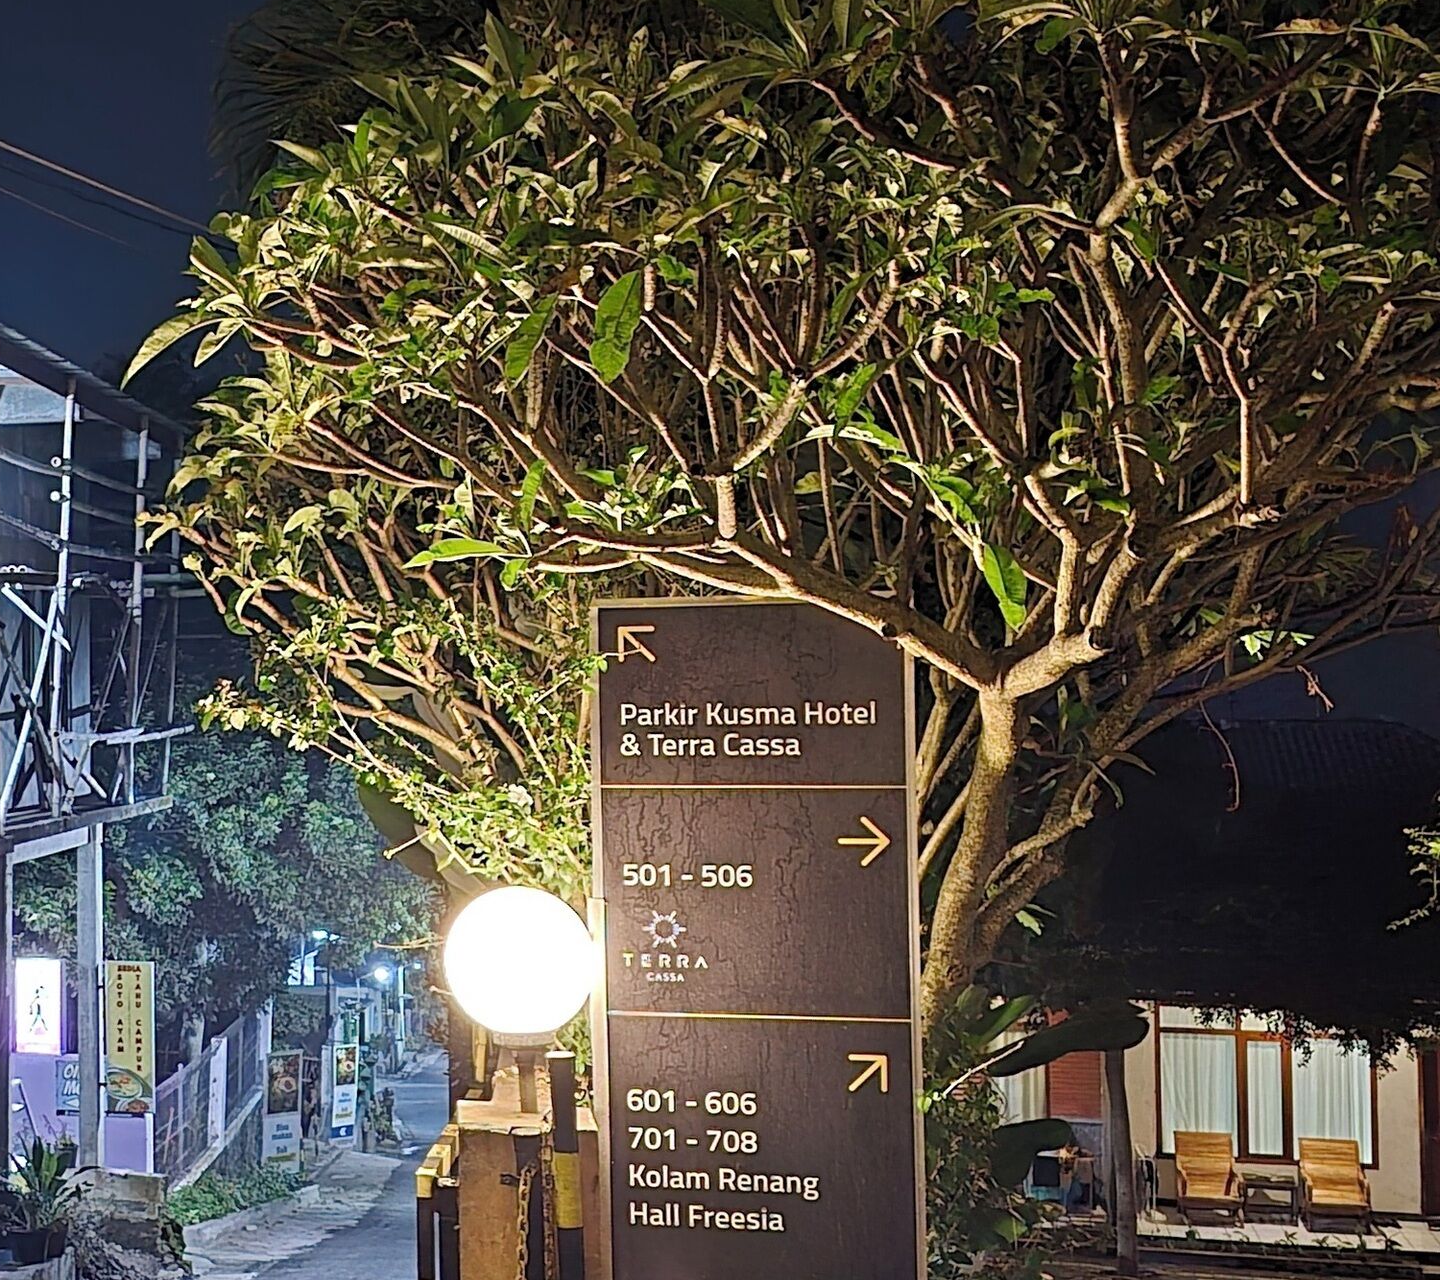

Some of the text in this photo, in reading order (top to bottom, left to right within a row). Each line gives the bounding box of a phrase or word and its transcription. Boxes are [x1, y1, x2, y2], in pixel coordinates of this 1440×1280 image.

[619, 700, 877, 727] Parkir Kusma Hotel
[619, 733, 802, 757] & Terra Cassa
[622, 863, 672, 888] 501
[700, 864, 754, 889] 506
[622, 952, 709, 969] TERRA
[645, 972, 685, 983] CASSA
[117, 1019, 125, 1053] AYAM
[135, 1020, 143, 1072] CAMPUR
[625, 1087, 676, 1113] 601
[704, 1091, 758, 1116] 606
[627, 1126, 676, 1151] 701
[705, 1129, 759, 1154] 708
[628, 1163, 820, 1201] Kolam Renang
[629, 1201, 786, 1232] Hall Freesia
